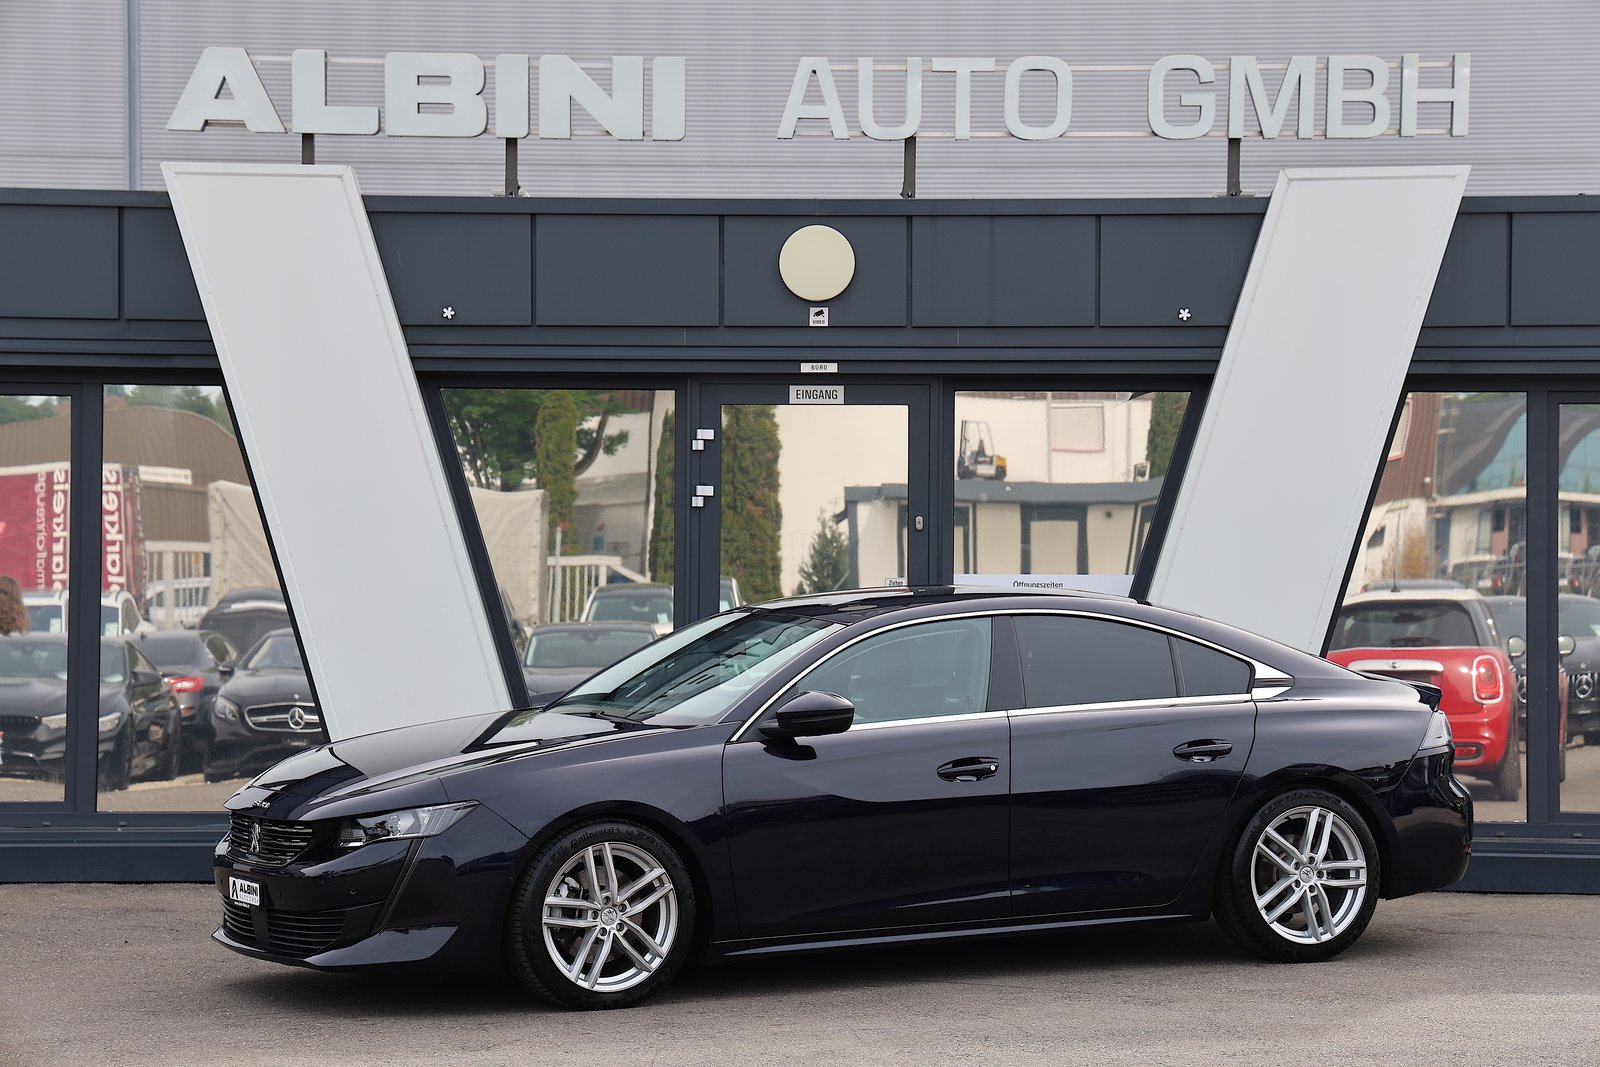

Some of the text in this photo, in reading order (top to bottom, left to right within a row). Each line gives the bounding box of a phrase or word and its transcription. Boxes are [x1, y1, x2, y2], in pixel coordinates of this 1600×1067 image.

[165, 47, 1471, 141] ALBINI AUTO GMBH
[795, 389, 838, 400] EINGANG
[1012, 580, 1064, 588] Öffnungszeiten
[570, 826, 613, 847] Continental
[240, 883, 259, 897] ALBINI
